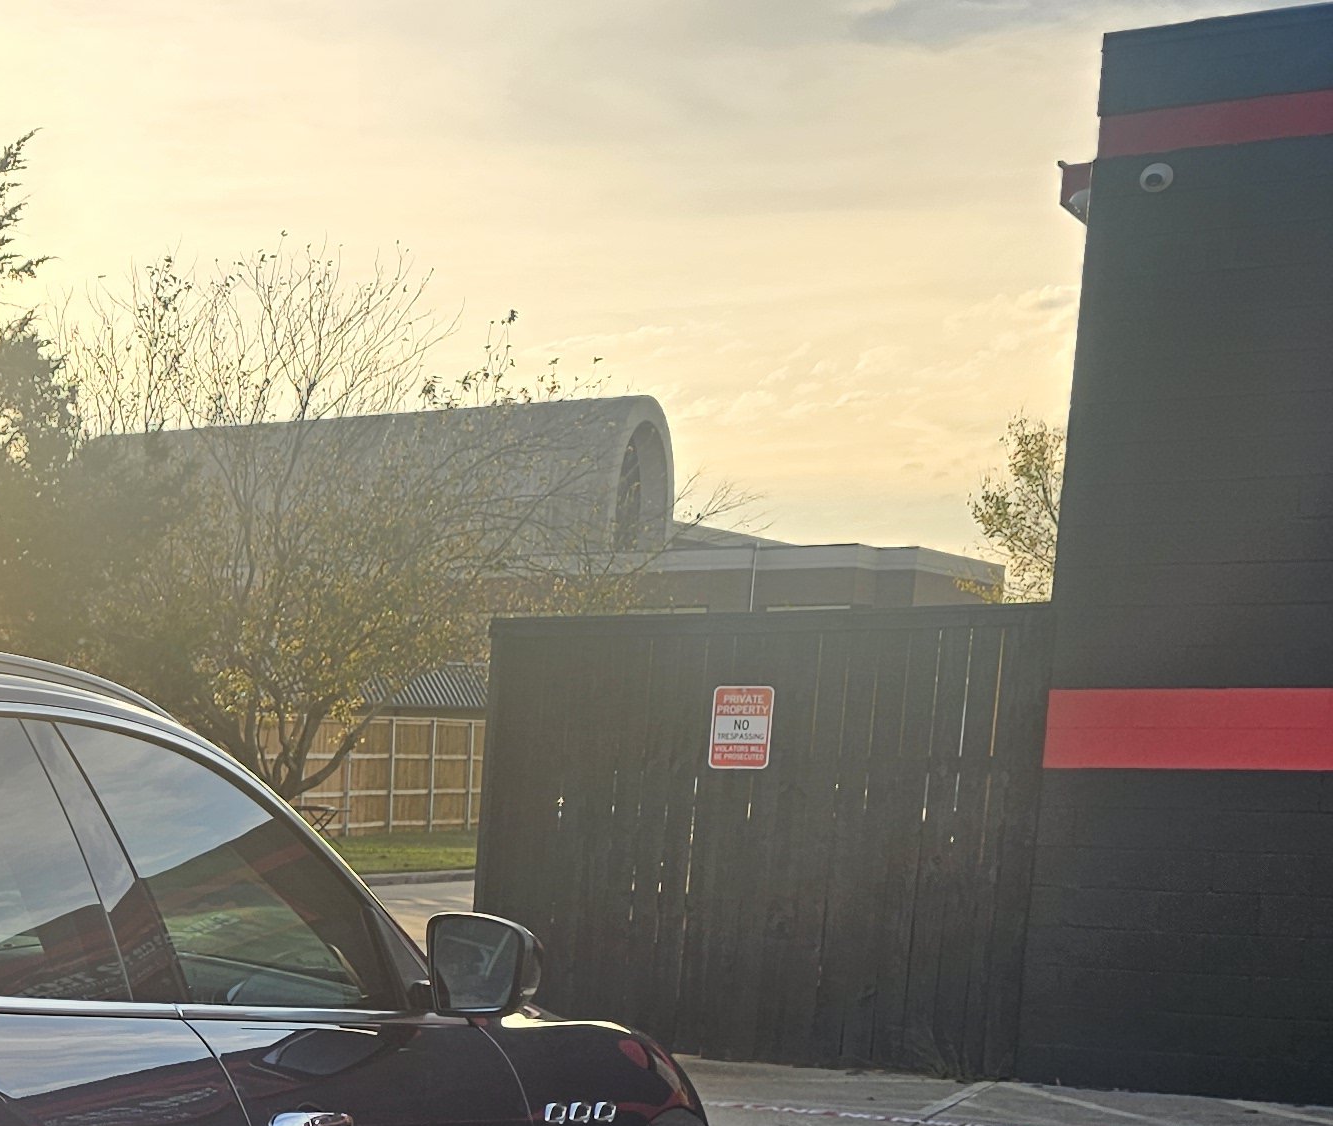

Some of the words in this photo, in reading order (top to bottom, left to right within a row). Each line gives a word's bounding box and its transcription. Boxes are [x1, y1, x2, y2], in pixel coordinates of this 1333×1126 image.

[724, 694, 764, 704] PRIVATE
[716, 704, 769, 715] PROPERTY
[733, 719, 750, 731] NO
